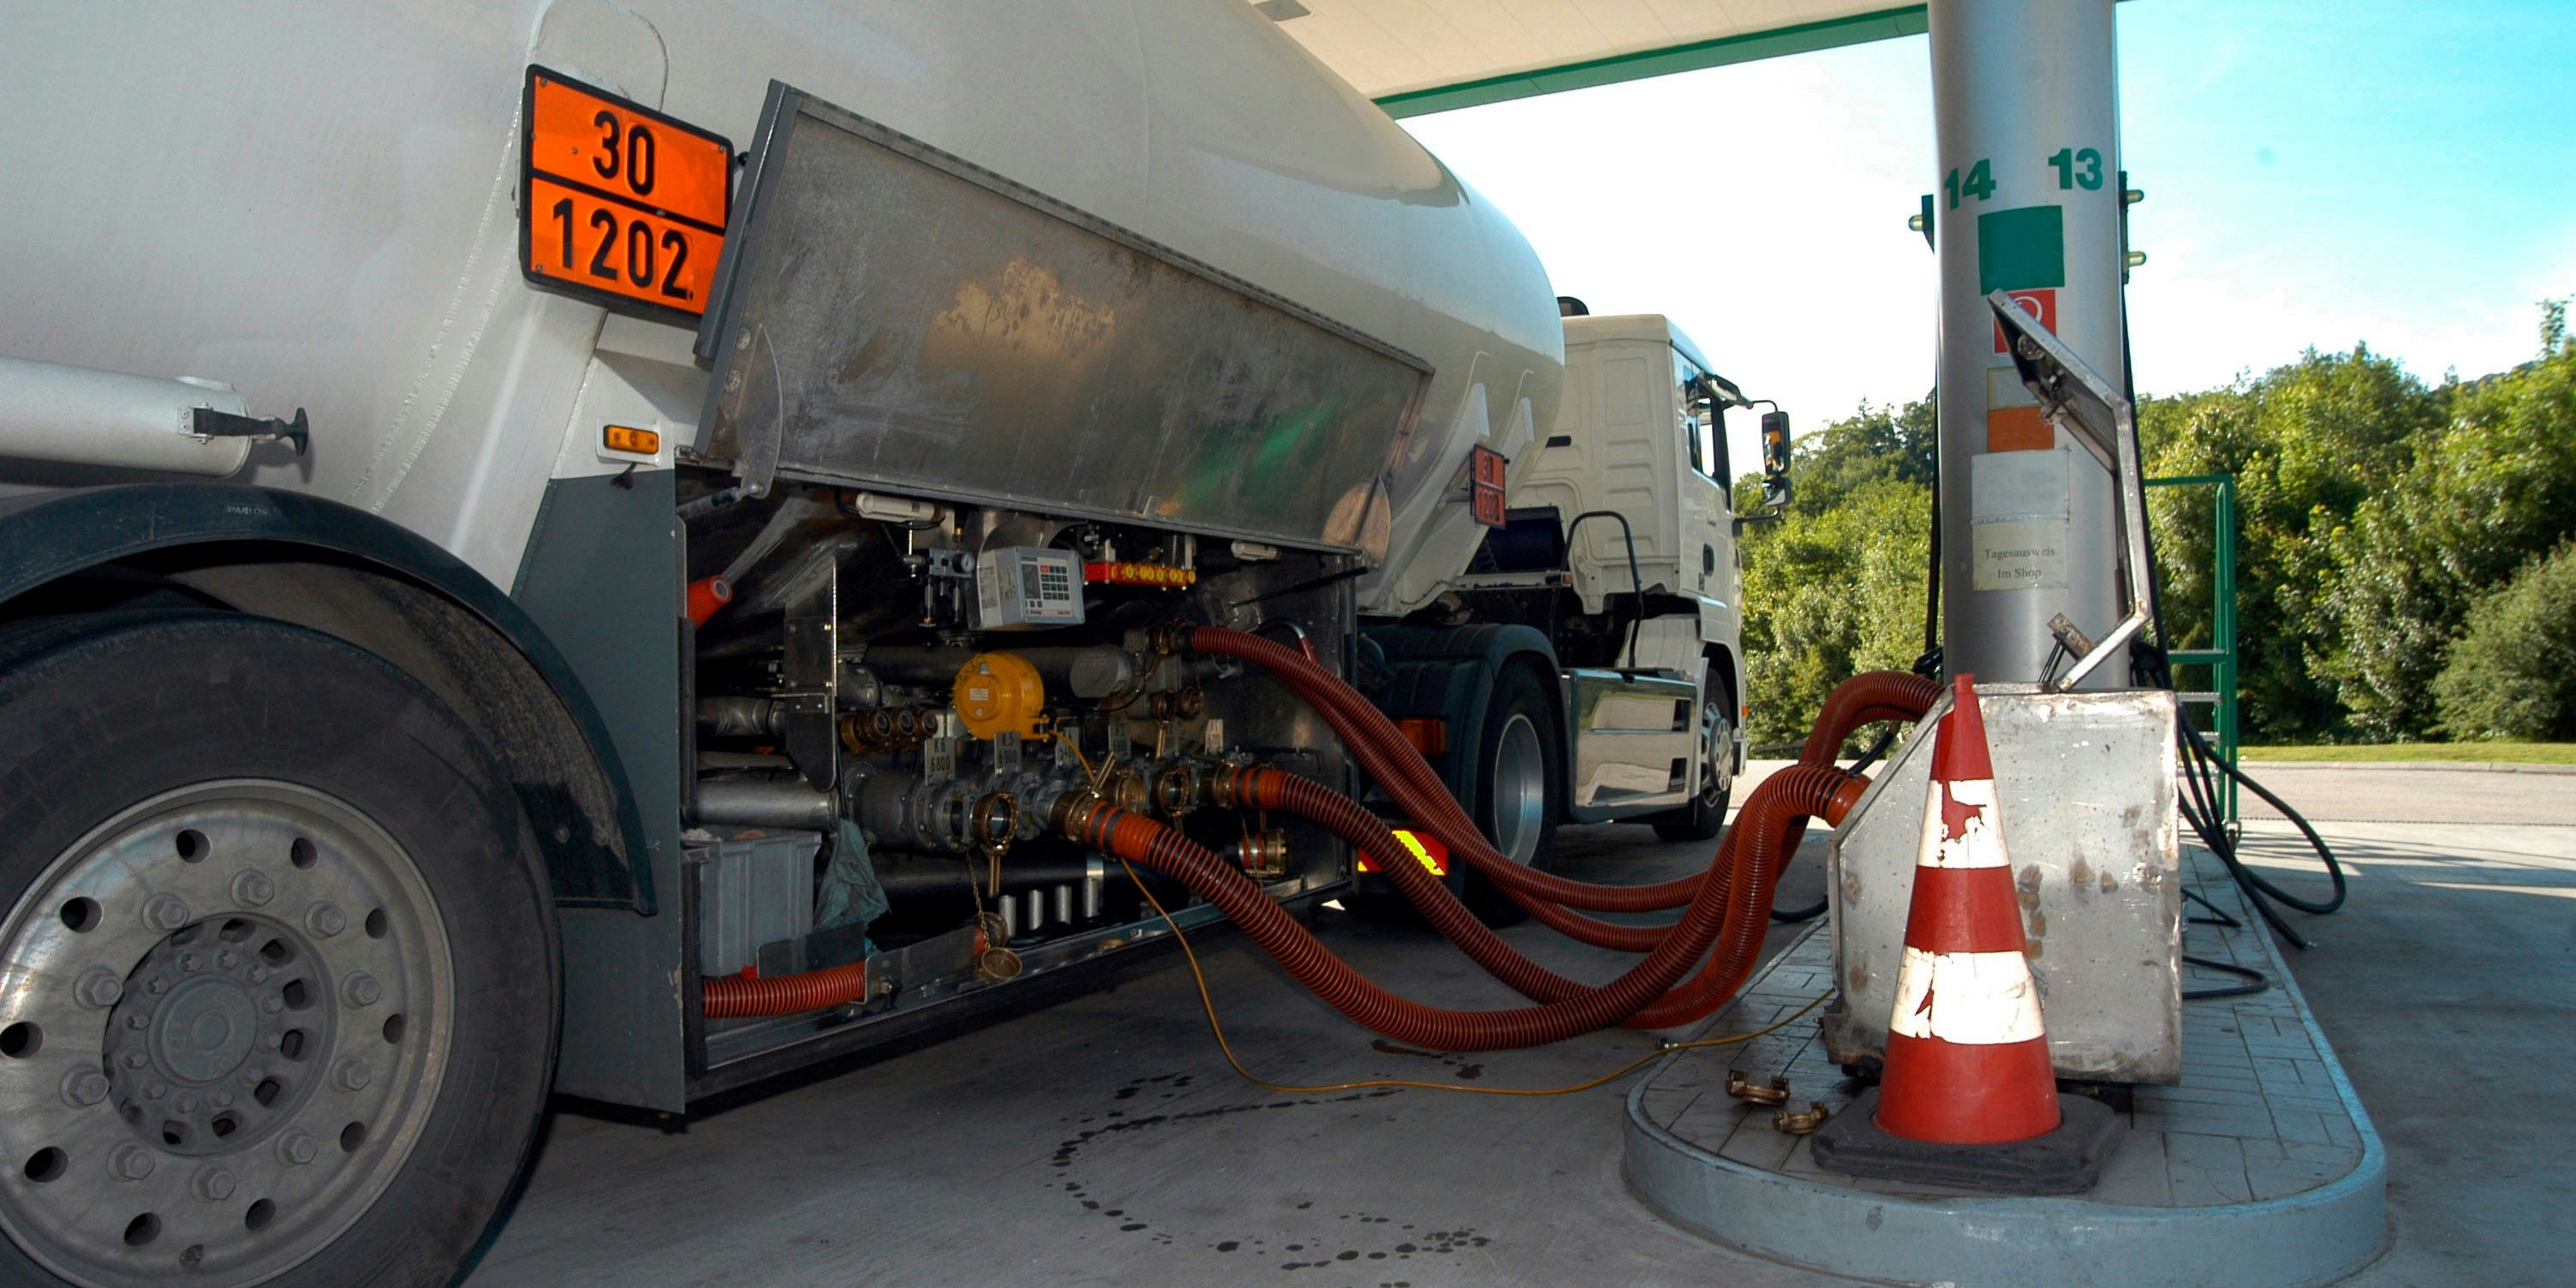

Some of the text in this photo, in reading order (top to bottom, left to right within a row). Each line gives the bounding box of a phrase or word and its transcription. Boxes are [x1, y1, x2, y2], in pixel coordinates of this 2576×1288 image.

[592, 110, 656, 196] 30
[2048, 147, 2103, 191] 13
[1944, 158, 1996, 210] 14
[552, 198, 690, 300] 1202
[1984, 546, 2055, 560] Tagesausweis
[1997, 567, 2042, 580] Im Shop
